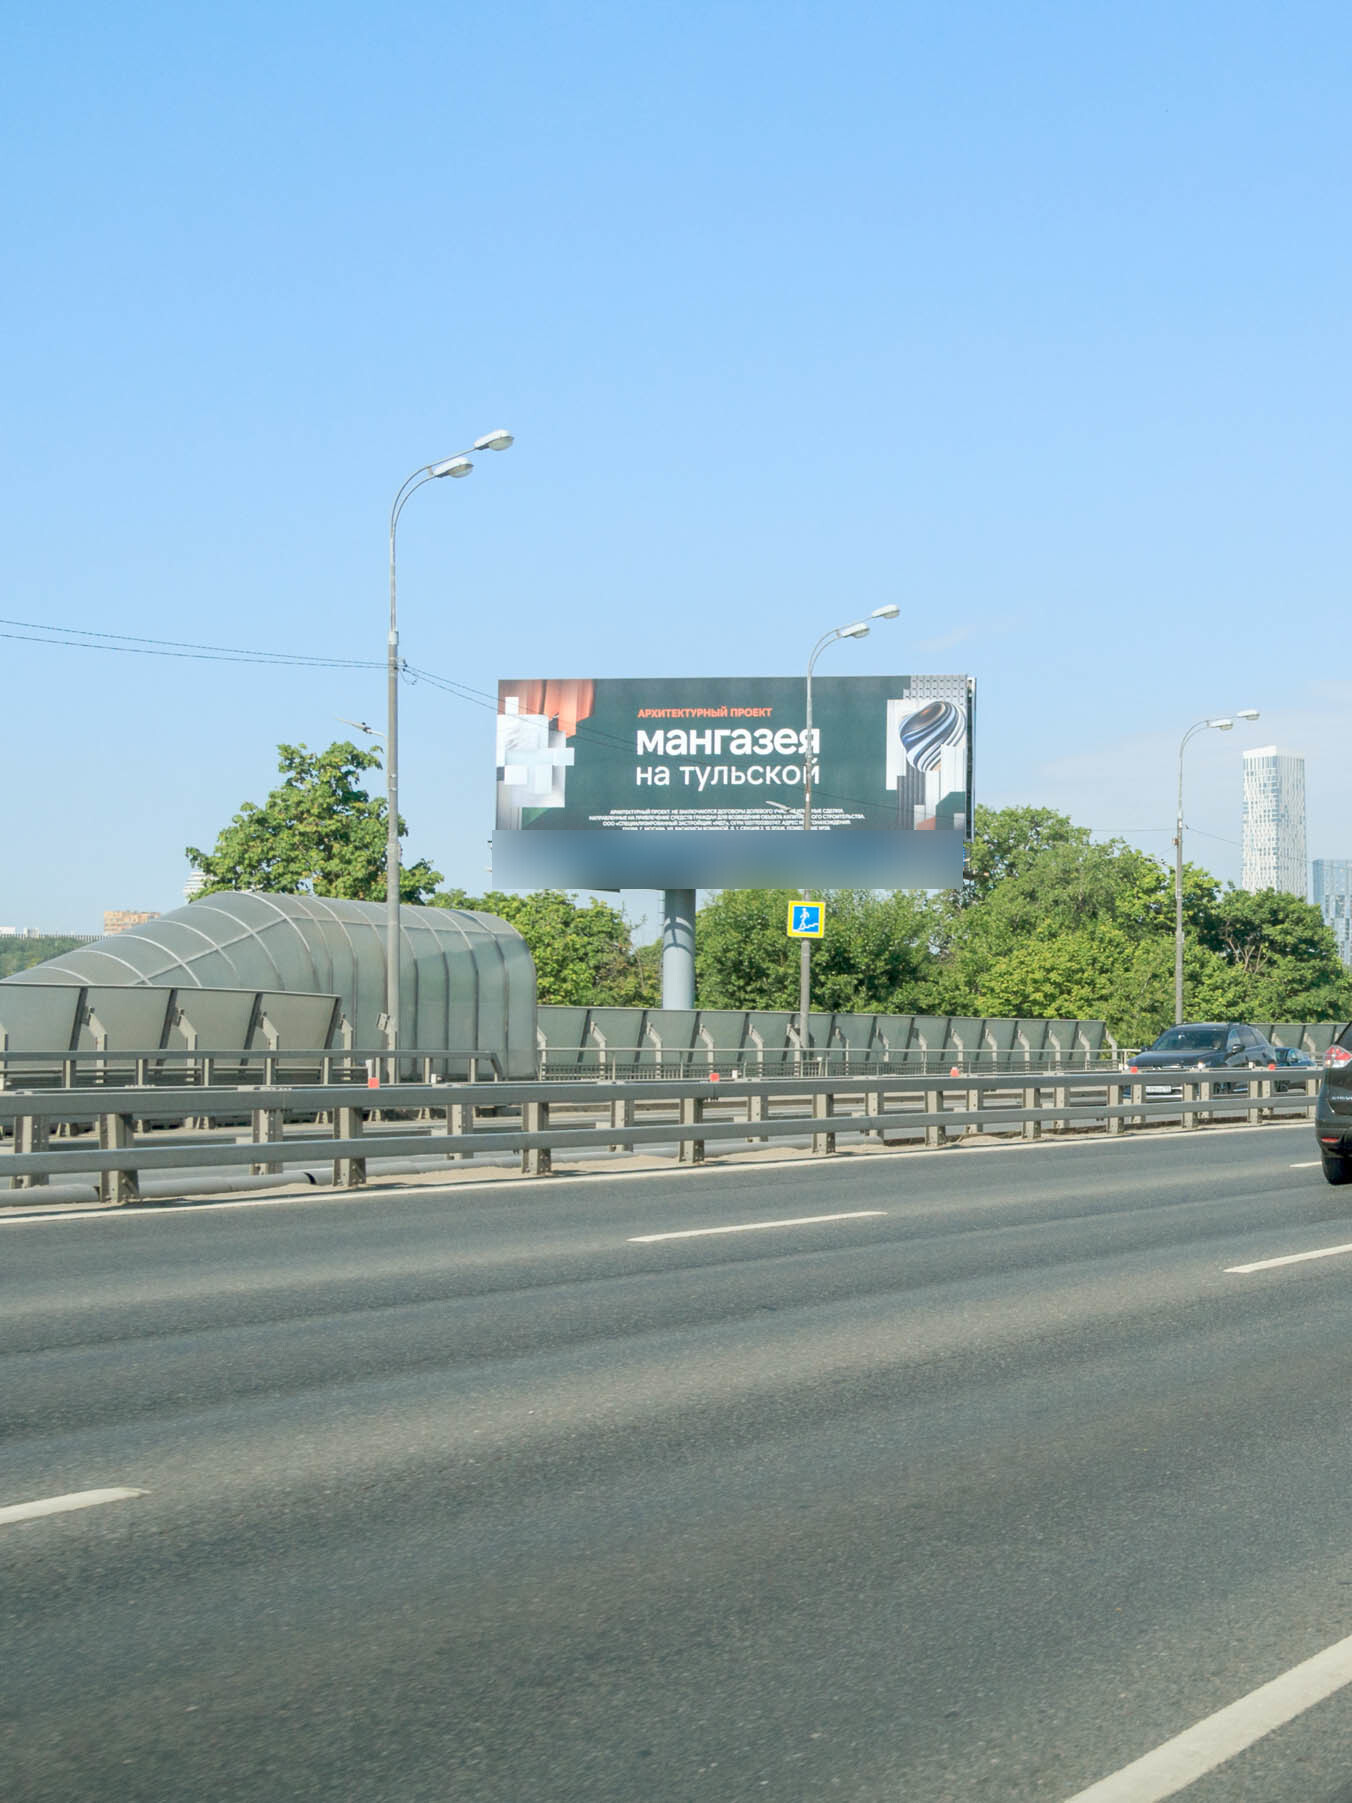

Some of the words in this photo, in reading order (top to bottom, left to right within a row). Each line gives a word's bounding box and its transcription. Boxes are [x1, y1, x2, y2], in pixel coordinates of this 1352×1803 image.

[637, 706, 728, 718] АРХИТЕКТУРНЫЙ
[730, 707, 773, 718] ПРОЕКТ
[636, 728, 820, 756] мангазея
[636, 766, 670, 786] на
[679, 758, 820, 792] тульской
